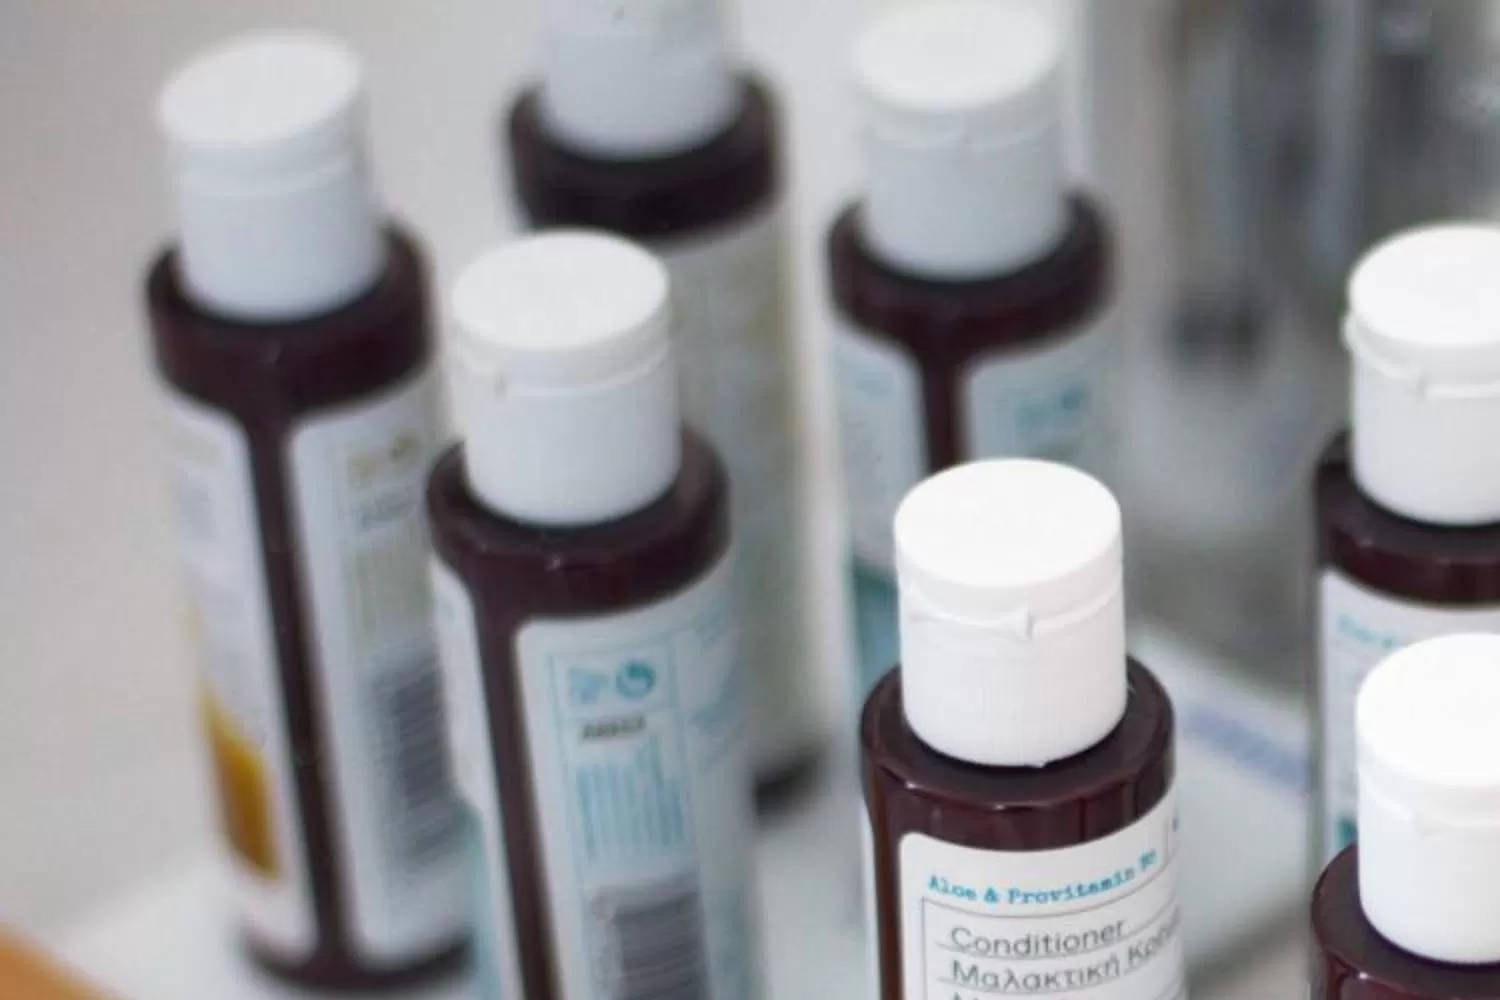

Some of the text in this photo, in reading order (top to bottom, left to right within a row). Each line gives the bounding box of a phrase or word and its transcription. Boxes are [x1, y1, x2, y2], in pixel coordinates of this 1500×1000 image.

[928, 874, 976, 899] Aloe
[1008, 866, 1135, 905] Provitamin
[951, 919, 1125, 957] Conditioner
[952, 957, 1121, 991] Μαλακτική
